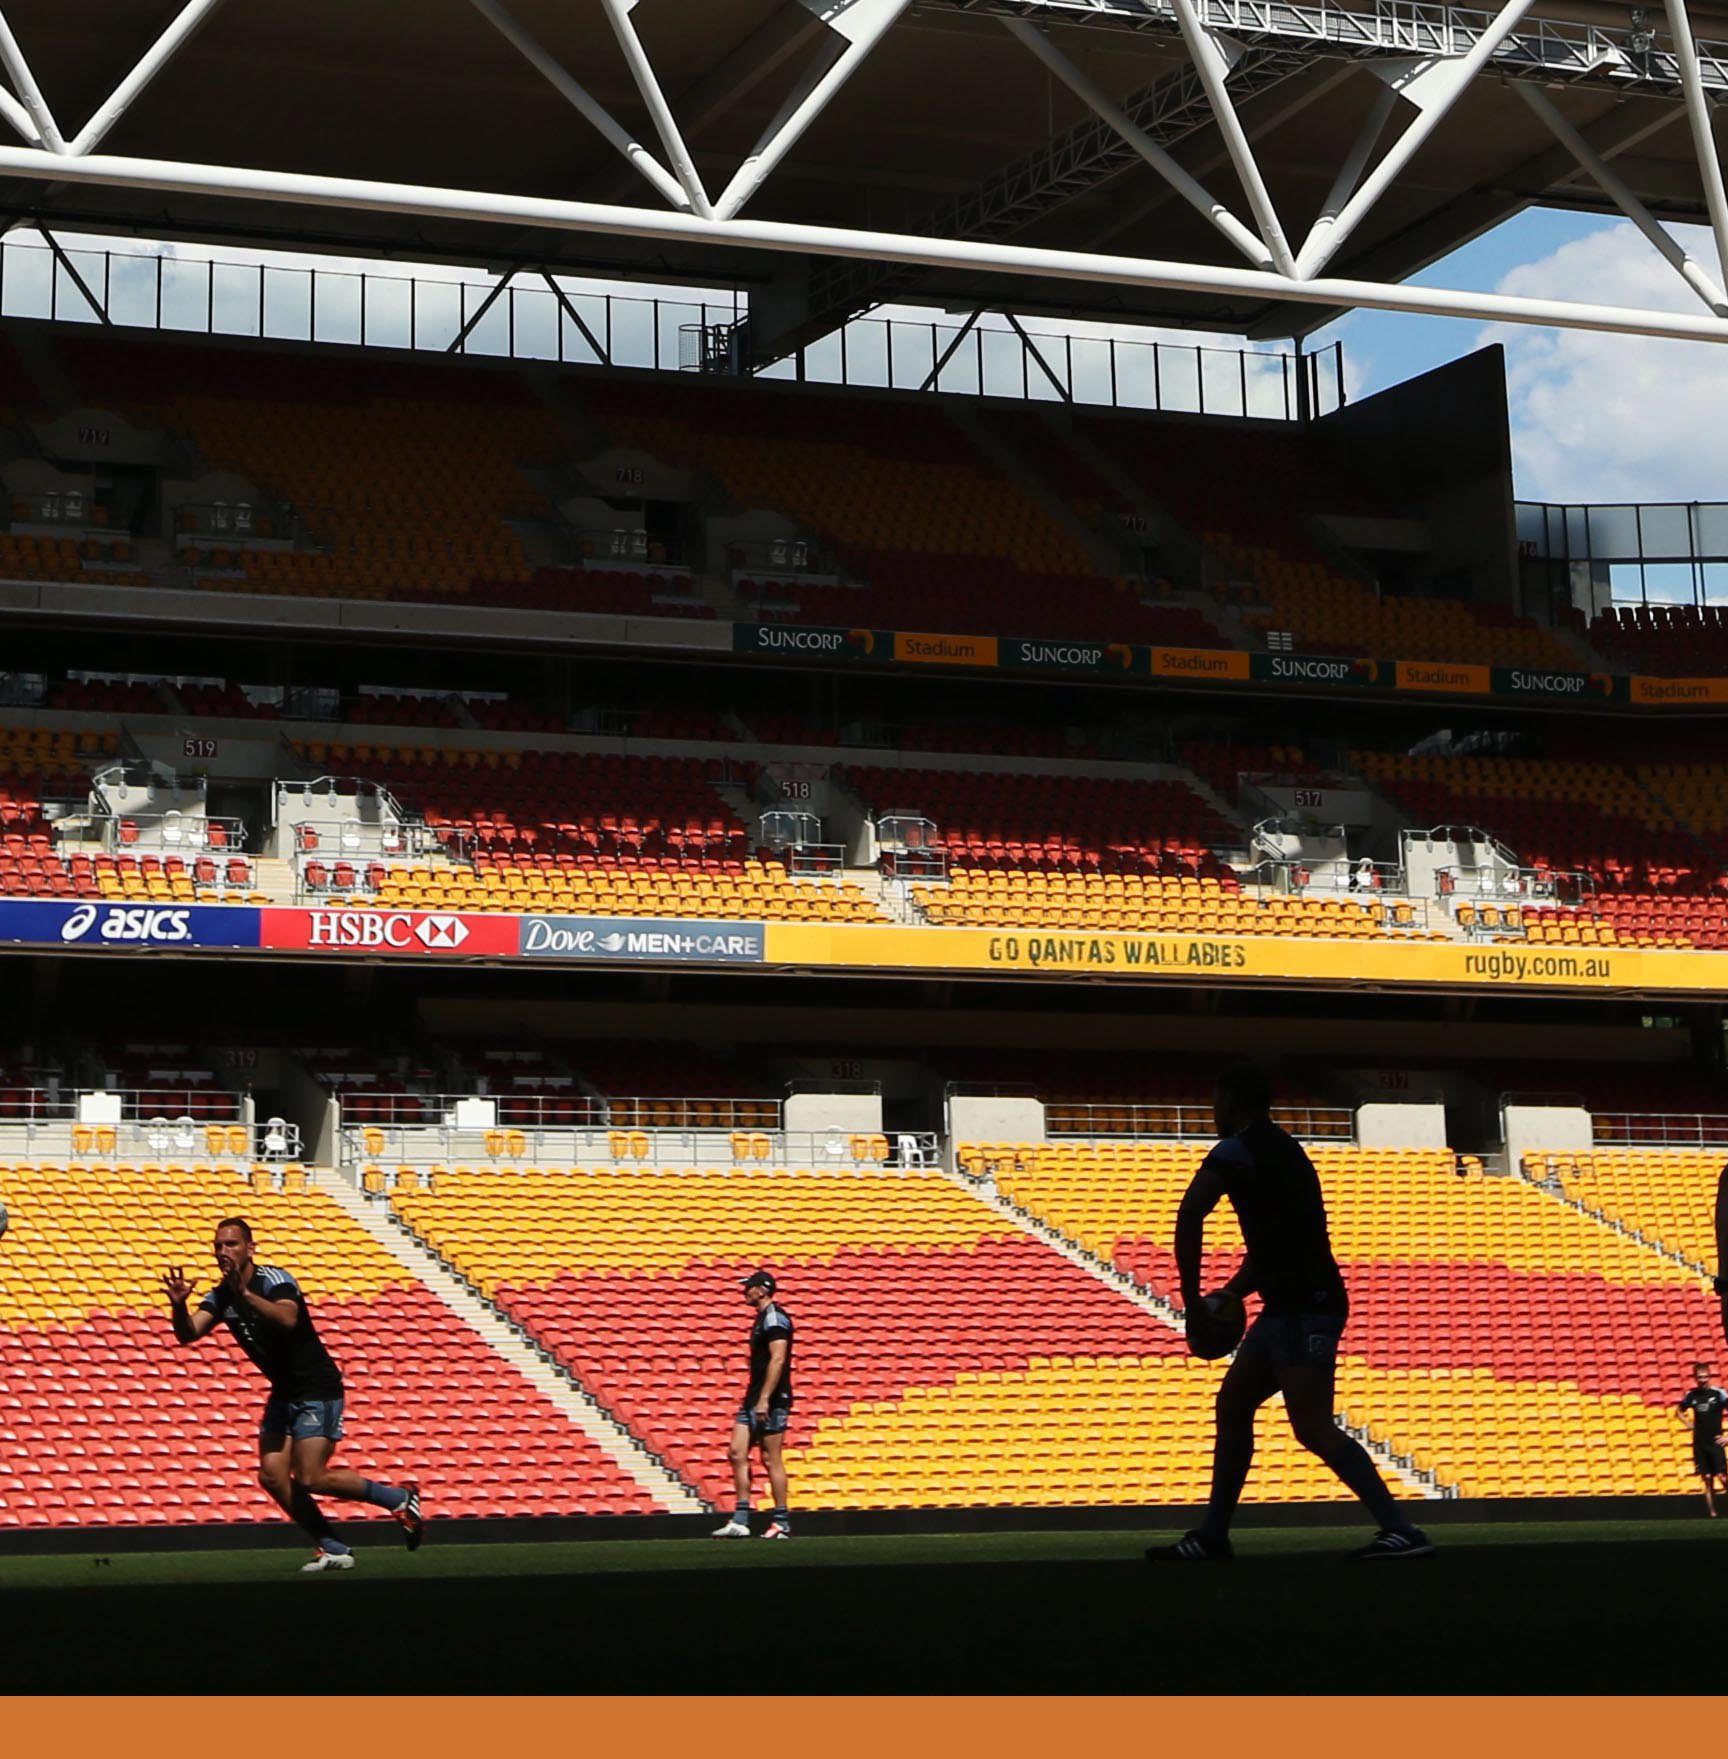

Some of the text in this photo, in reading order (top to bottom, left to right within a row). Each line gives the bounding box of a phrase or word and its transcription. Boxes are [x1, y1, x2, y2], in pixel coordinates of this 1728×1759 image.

[617, 467, 644, 484] 718
[758, 627, 843, 651] SUNCORP
[905, 639, 976, 658] Stadium
[1020, 642, 1102, 666] SUNCORP
[1161, 652, 1229, 672] Stadium
[1272, 656, 1349, 680] SUNCORP
[1404, 666, 1471, 685] Stadium
[1510, 670, 1585, 693] SUNCORP
[1639, 680, 1710, 699] Stadium
[184, 738, 217, 758] 519
[781, 781, 810, 799] 518
[1294, 791, 1322, 808] 517
[308, 911, 413, 947] HSBC
[525, 918, 759, 957] Dove MEN+CARE
[989, 937, 1246, 968] GO QANTAS WALLABIES
[1465, 952, 1611, 980] rugby.com.au
